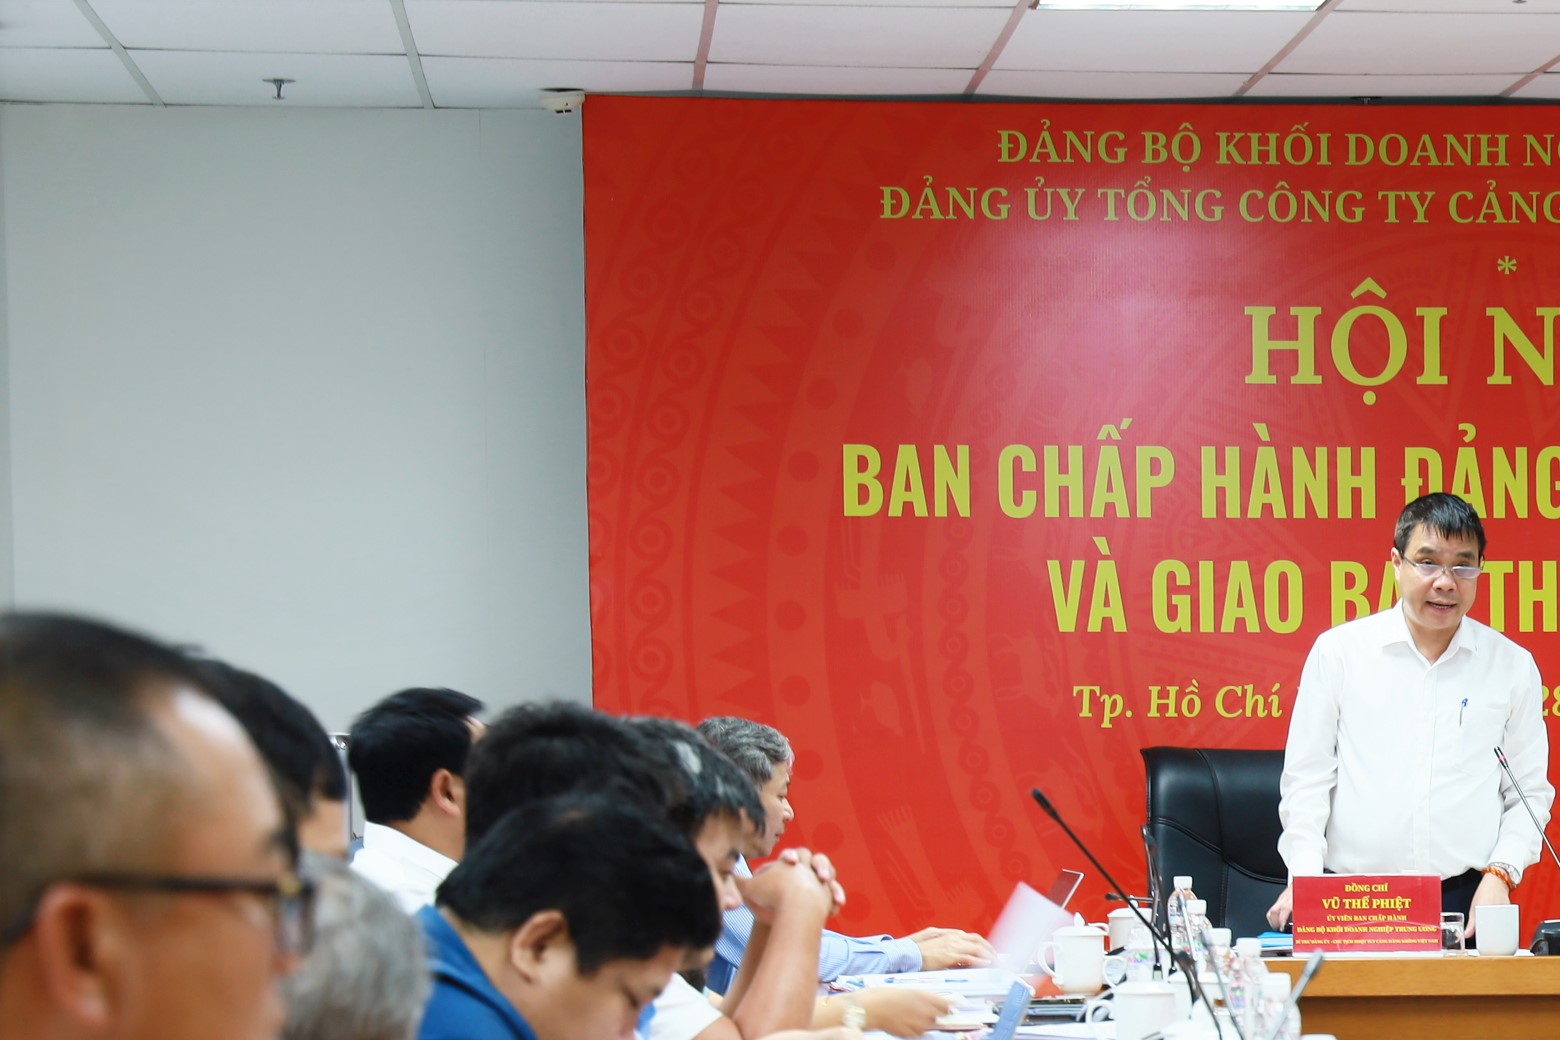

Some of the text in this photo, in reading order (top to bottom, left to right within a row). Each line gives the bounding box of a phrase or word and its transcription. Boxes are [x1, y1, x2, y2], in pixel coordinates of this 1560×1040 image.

[998, 119, 1128, 164] ĐẢNG
[1142, 122, 1203, 173] BỘ
[1216, 121, 1332, 166] KHỐI
[1345, 133, 1509, 167] DOANH
[880, 175, 1011, 220] ĐẢNG
[1025, 176, 1086, 221] ỦY
[1097, 175, 1225, 222] TỔNG
[1238, 180, 1366, 223] CÔNG
[1378, 190, 1436, 224] TY
[1243, 276, 1449, 406] HỘI
[842, 443, 972, 518] BAN
[997, 417, 1176, 519] CHẤP
[1201, 422, 1377, 520] HÀNH
[1047, 536, 1128, 633] VÀ
[1151, 559, 1304, 634] GIAO
[1073, 685, 1133, 729] Tp.
[1148, 679, 1202, 719] Hồ
[1215, 682, 1283, 719] Chí
[1322, 894, 1412, 911] VŨ THẾ PHIỆT
[1345, 882, 1388, 892] ĐỒNG CHÍ
